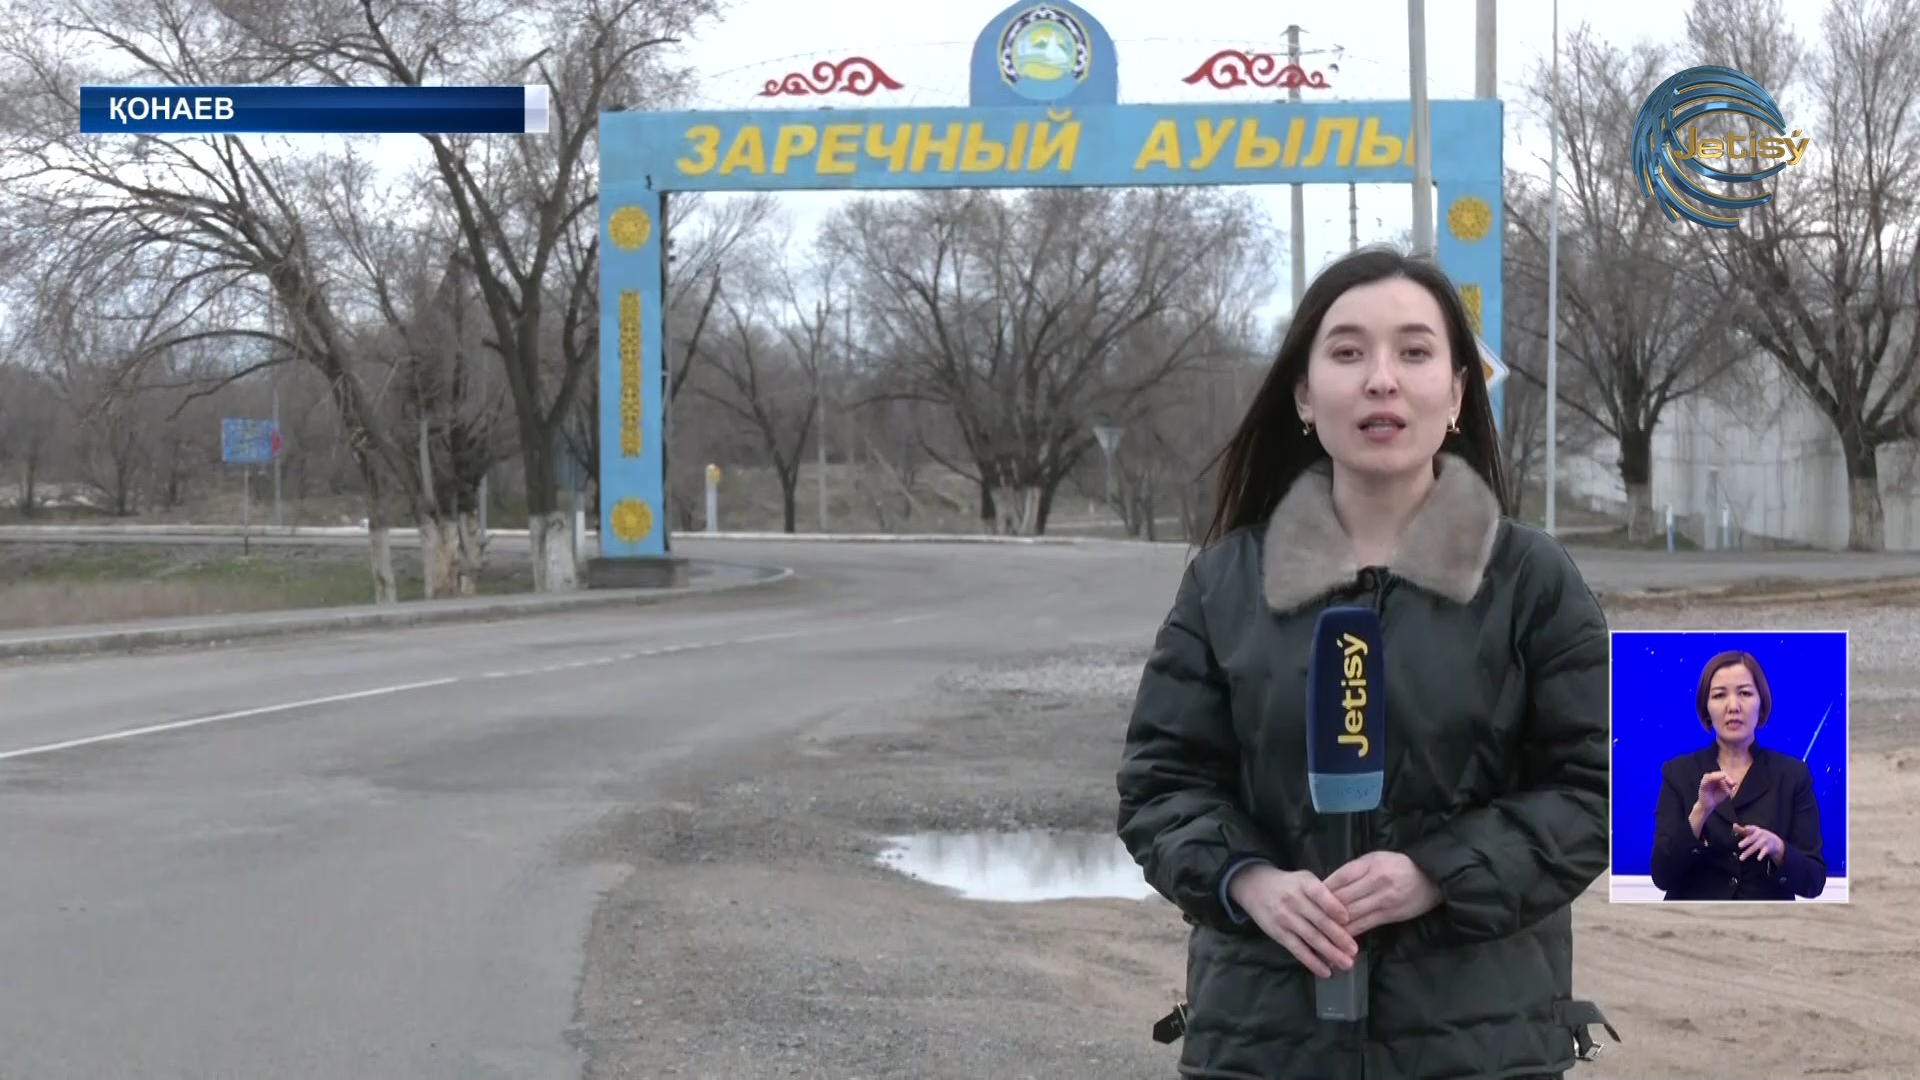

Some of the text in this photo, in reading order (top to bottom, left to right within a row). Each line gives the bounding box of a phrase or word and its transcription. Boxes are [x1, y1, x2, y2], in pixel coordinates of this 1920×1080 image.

[676, 109, 1415, 177] ЗАРЕЧНЫЙ АУЫЛЫ
[1336, 632, 1369, 758] Jetisý
